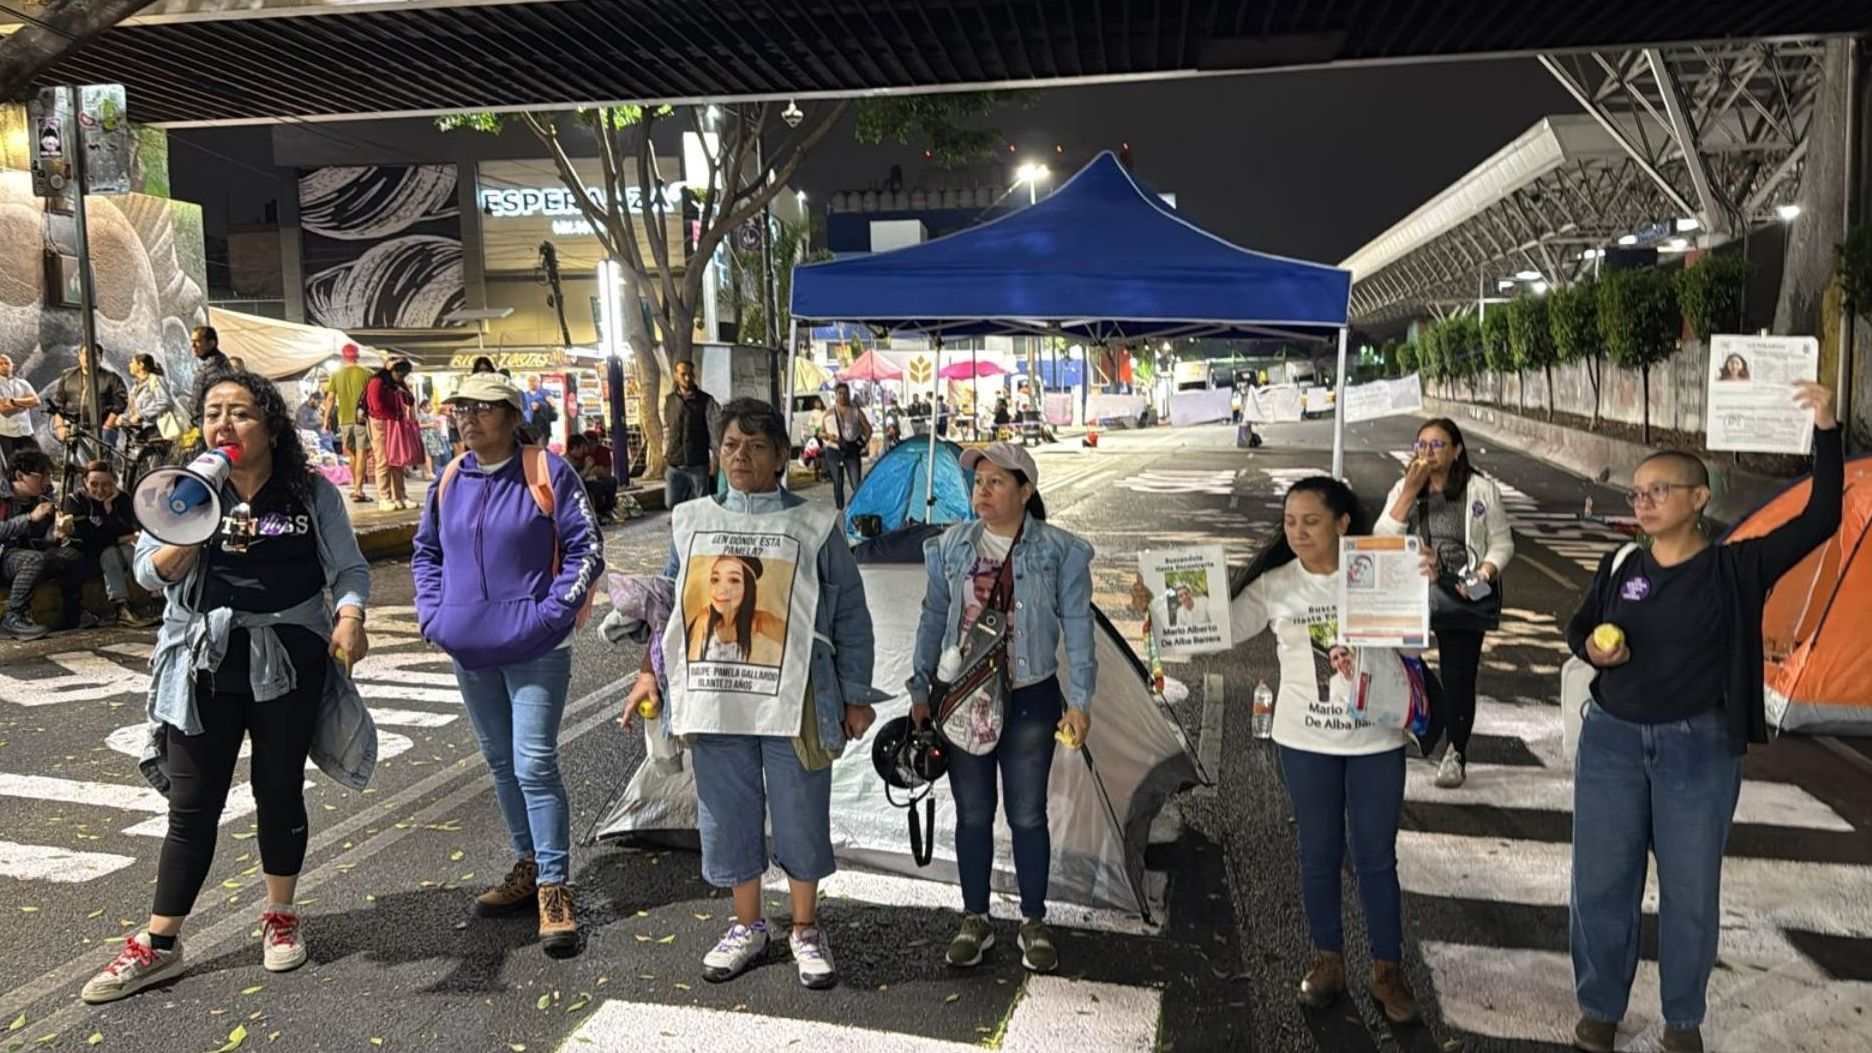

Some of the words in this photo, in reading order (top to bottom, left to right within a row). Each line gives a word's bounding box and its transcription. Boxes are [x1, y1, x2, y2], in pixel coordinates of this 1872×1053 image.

[482, 188, 672, 212] ESPERAZA
[500, 352, 549, 368] TORTAS
[724, 546, 763, 556] PAMELA?
[1309, 605, 1337, 613] Busca
[1325, 612, 1338, 620] En
[1163, 627, 1185, 636] Mario
[1187, 624, 1218, 635] Alberto
[1161, 639, 1172, 647] De
[1174, 637, 1192, 646] Alba
[713, 667, 740, 679] PAMELA
[741, 668, 778, 682] GALLARDO
[1309, 702, 1343, 716] Mario
[1305, 715, 1321, 728] De
[1324, 717, 1352, 730] Alba
